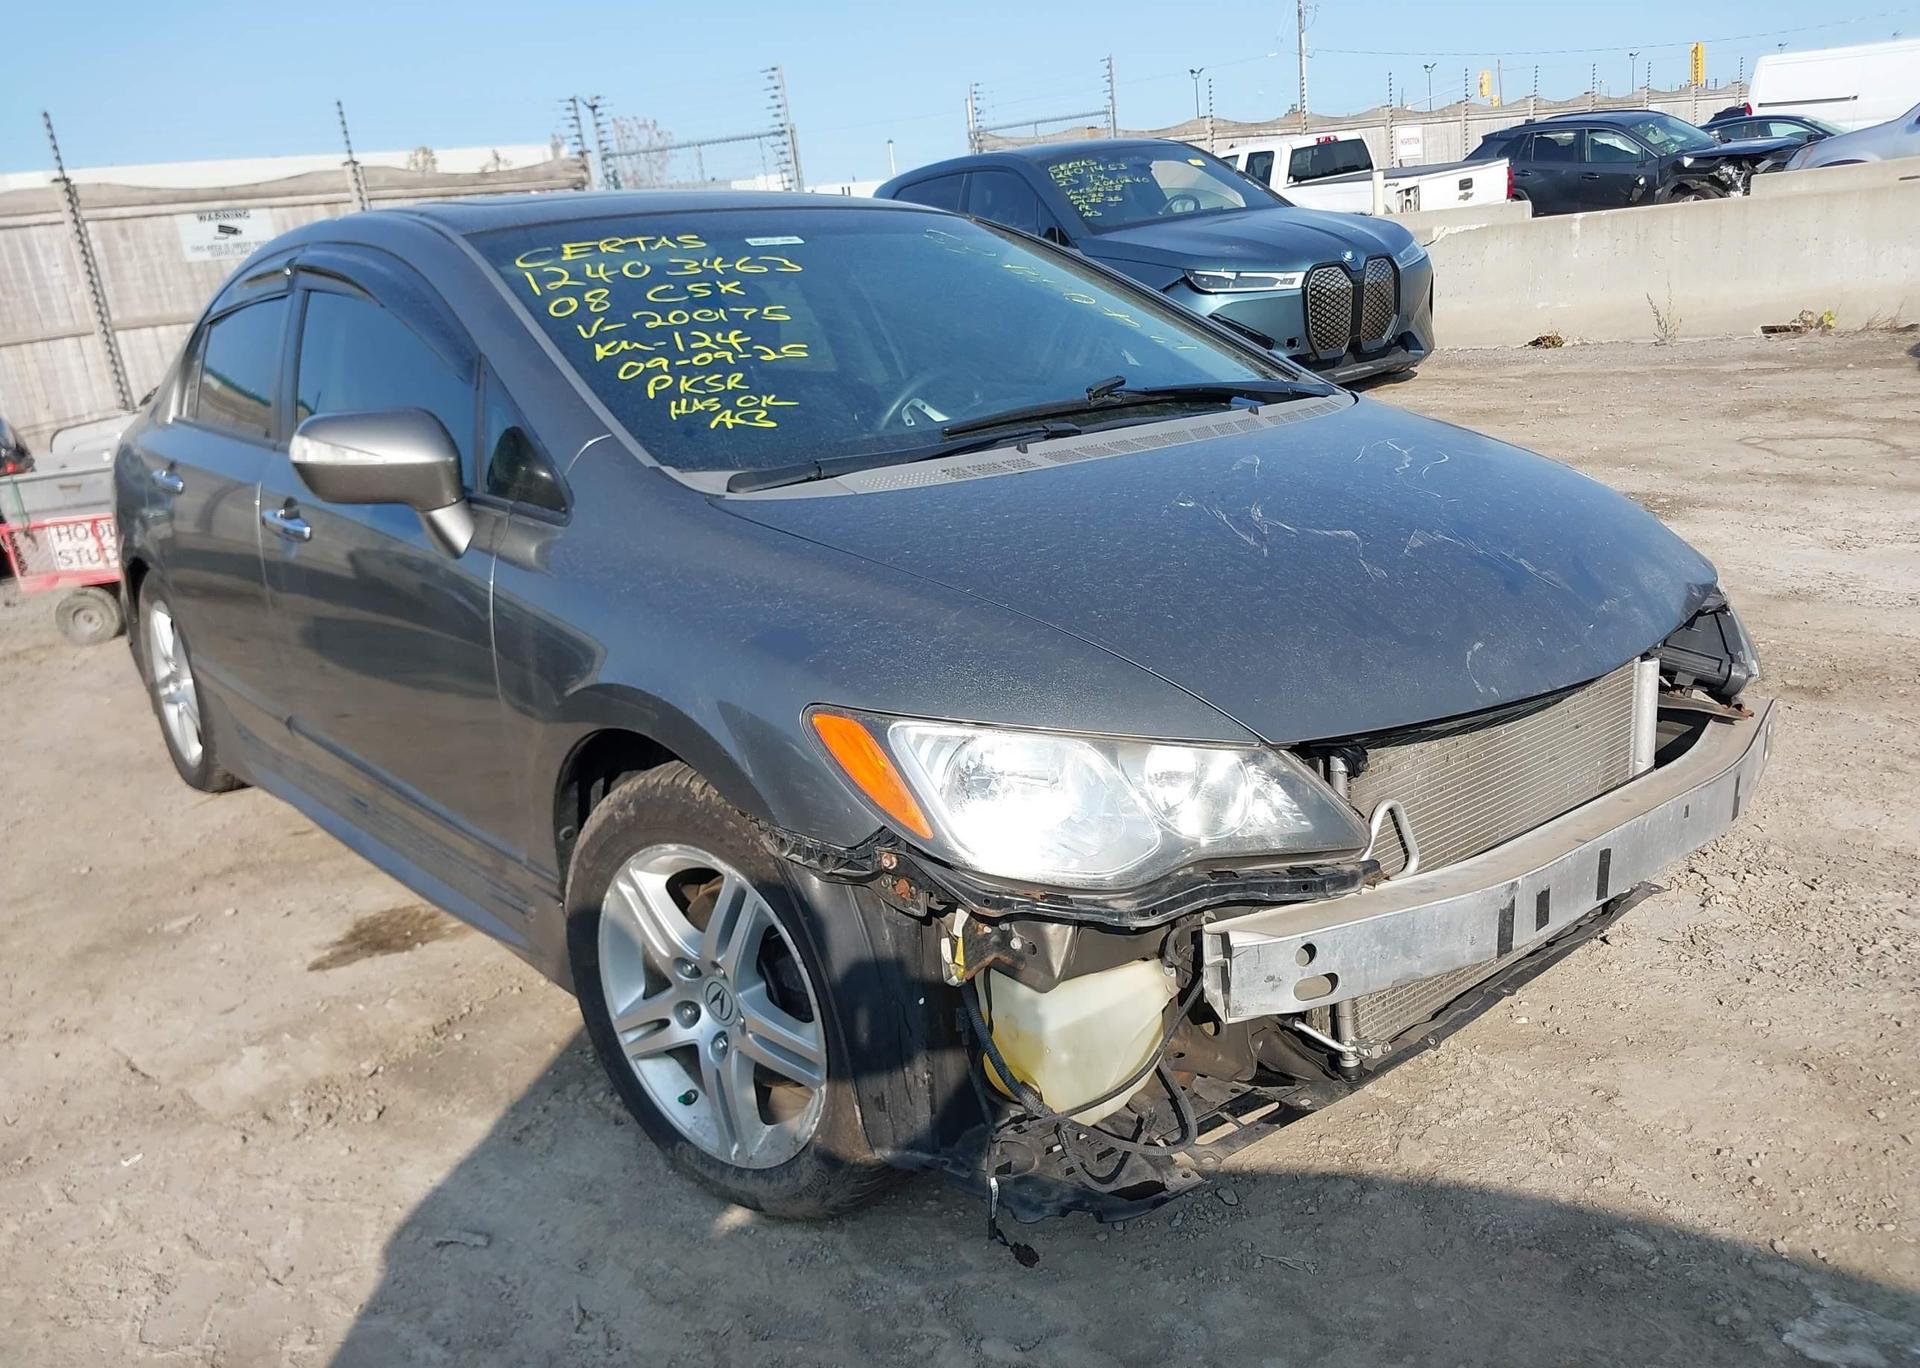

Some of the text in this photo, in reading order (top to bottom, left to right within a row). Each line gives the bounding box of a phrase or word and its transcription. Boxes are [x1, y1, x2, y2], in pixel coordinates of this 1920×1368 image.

[515, 235, 706, 268] CERTAS
[524, 260, 651, 296] 1240
[548, 288, 611, 317] 08
[617, 344, 809, 380] 09-09-25
[736, 394, 800, 407] OK
